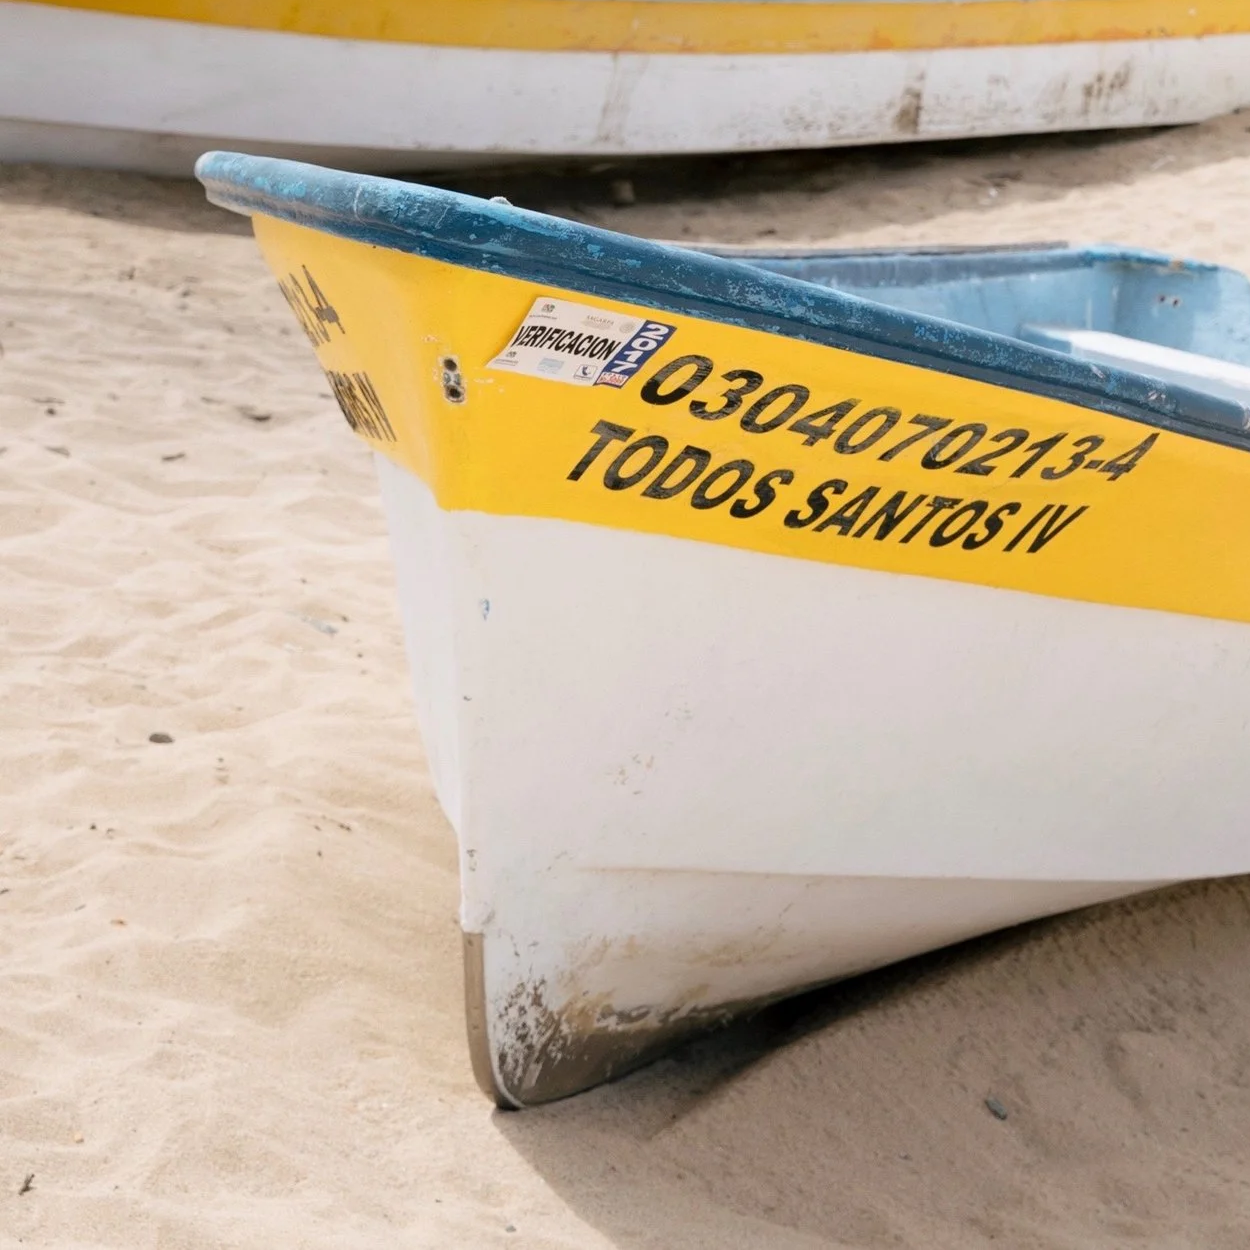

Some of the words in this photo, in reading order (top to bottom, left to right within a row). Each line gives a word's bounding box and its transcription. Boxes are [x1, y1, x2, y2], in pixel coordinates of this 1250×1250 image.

[512, 325, 621, 361] VERIFICACION
[607, 323, 669, 374] 2017
[641, 353, 1161, 482] 0304070213-4
[566, 419, 795, 519] TODOS
[783, 479, 1022, 552] SANTOS
[1002, 503, 1091, 554] IV
